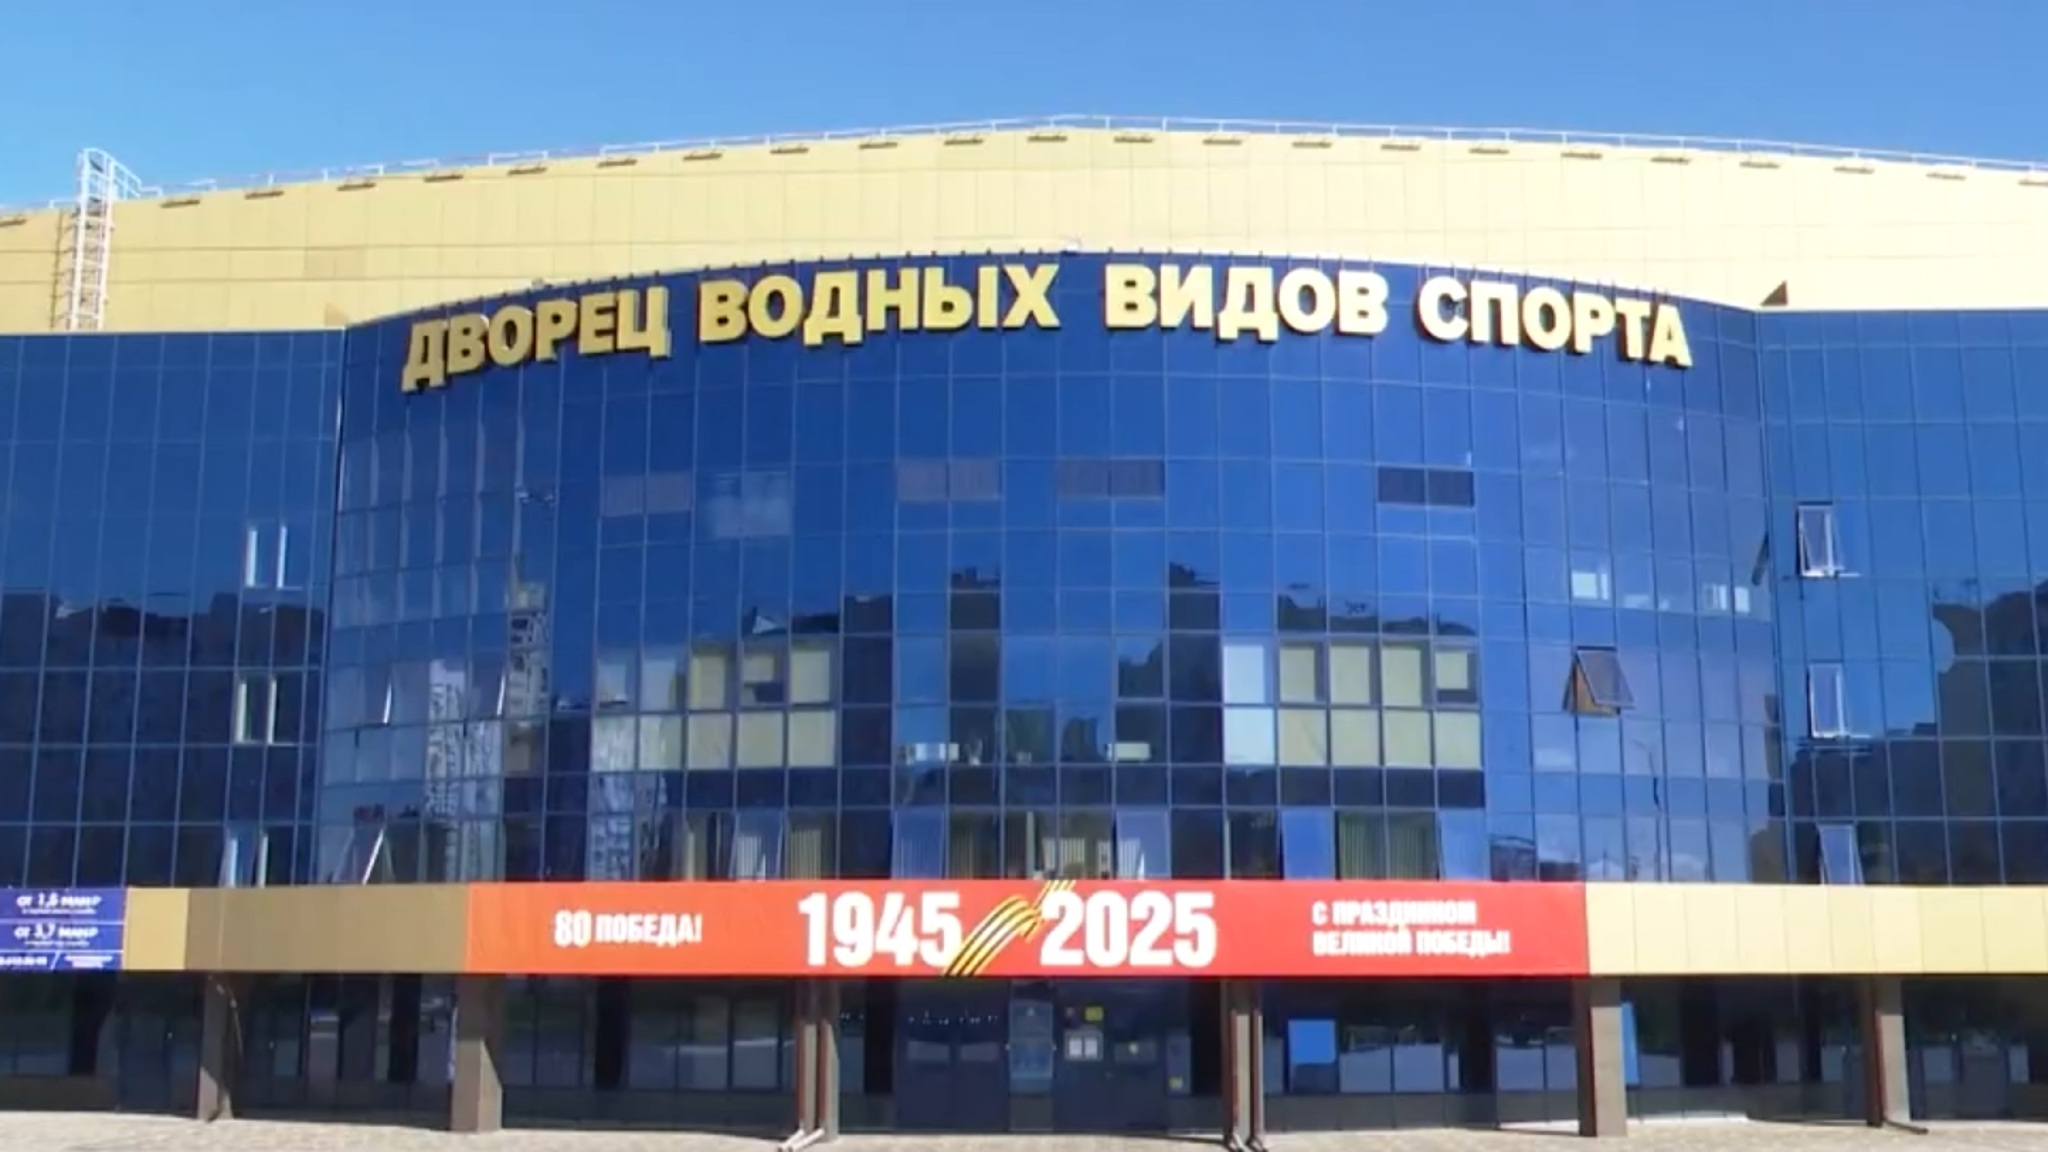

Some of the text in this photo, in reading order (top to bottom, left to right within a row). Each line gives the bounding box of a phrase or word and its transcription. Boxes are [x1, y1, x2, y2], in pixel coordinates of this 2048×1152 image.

[402, 263, 1693, 393] ДВОРЕЦ ВОДНЫХ ВИДОВ СПОРТА
[554, 909, 703, 947] 80 ПОБЕДА!
[798, 891, 961, 968] 1945
[1040, 890, 1217, 968] 2025
[1312, 900, 1477, 929] С ПРАЗДНИКОМ
[1312, 927, 1511, 958] ВЕЛИКОЙ ПОБЕДЫ!
